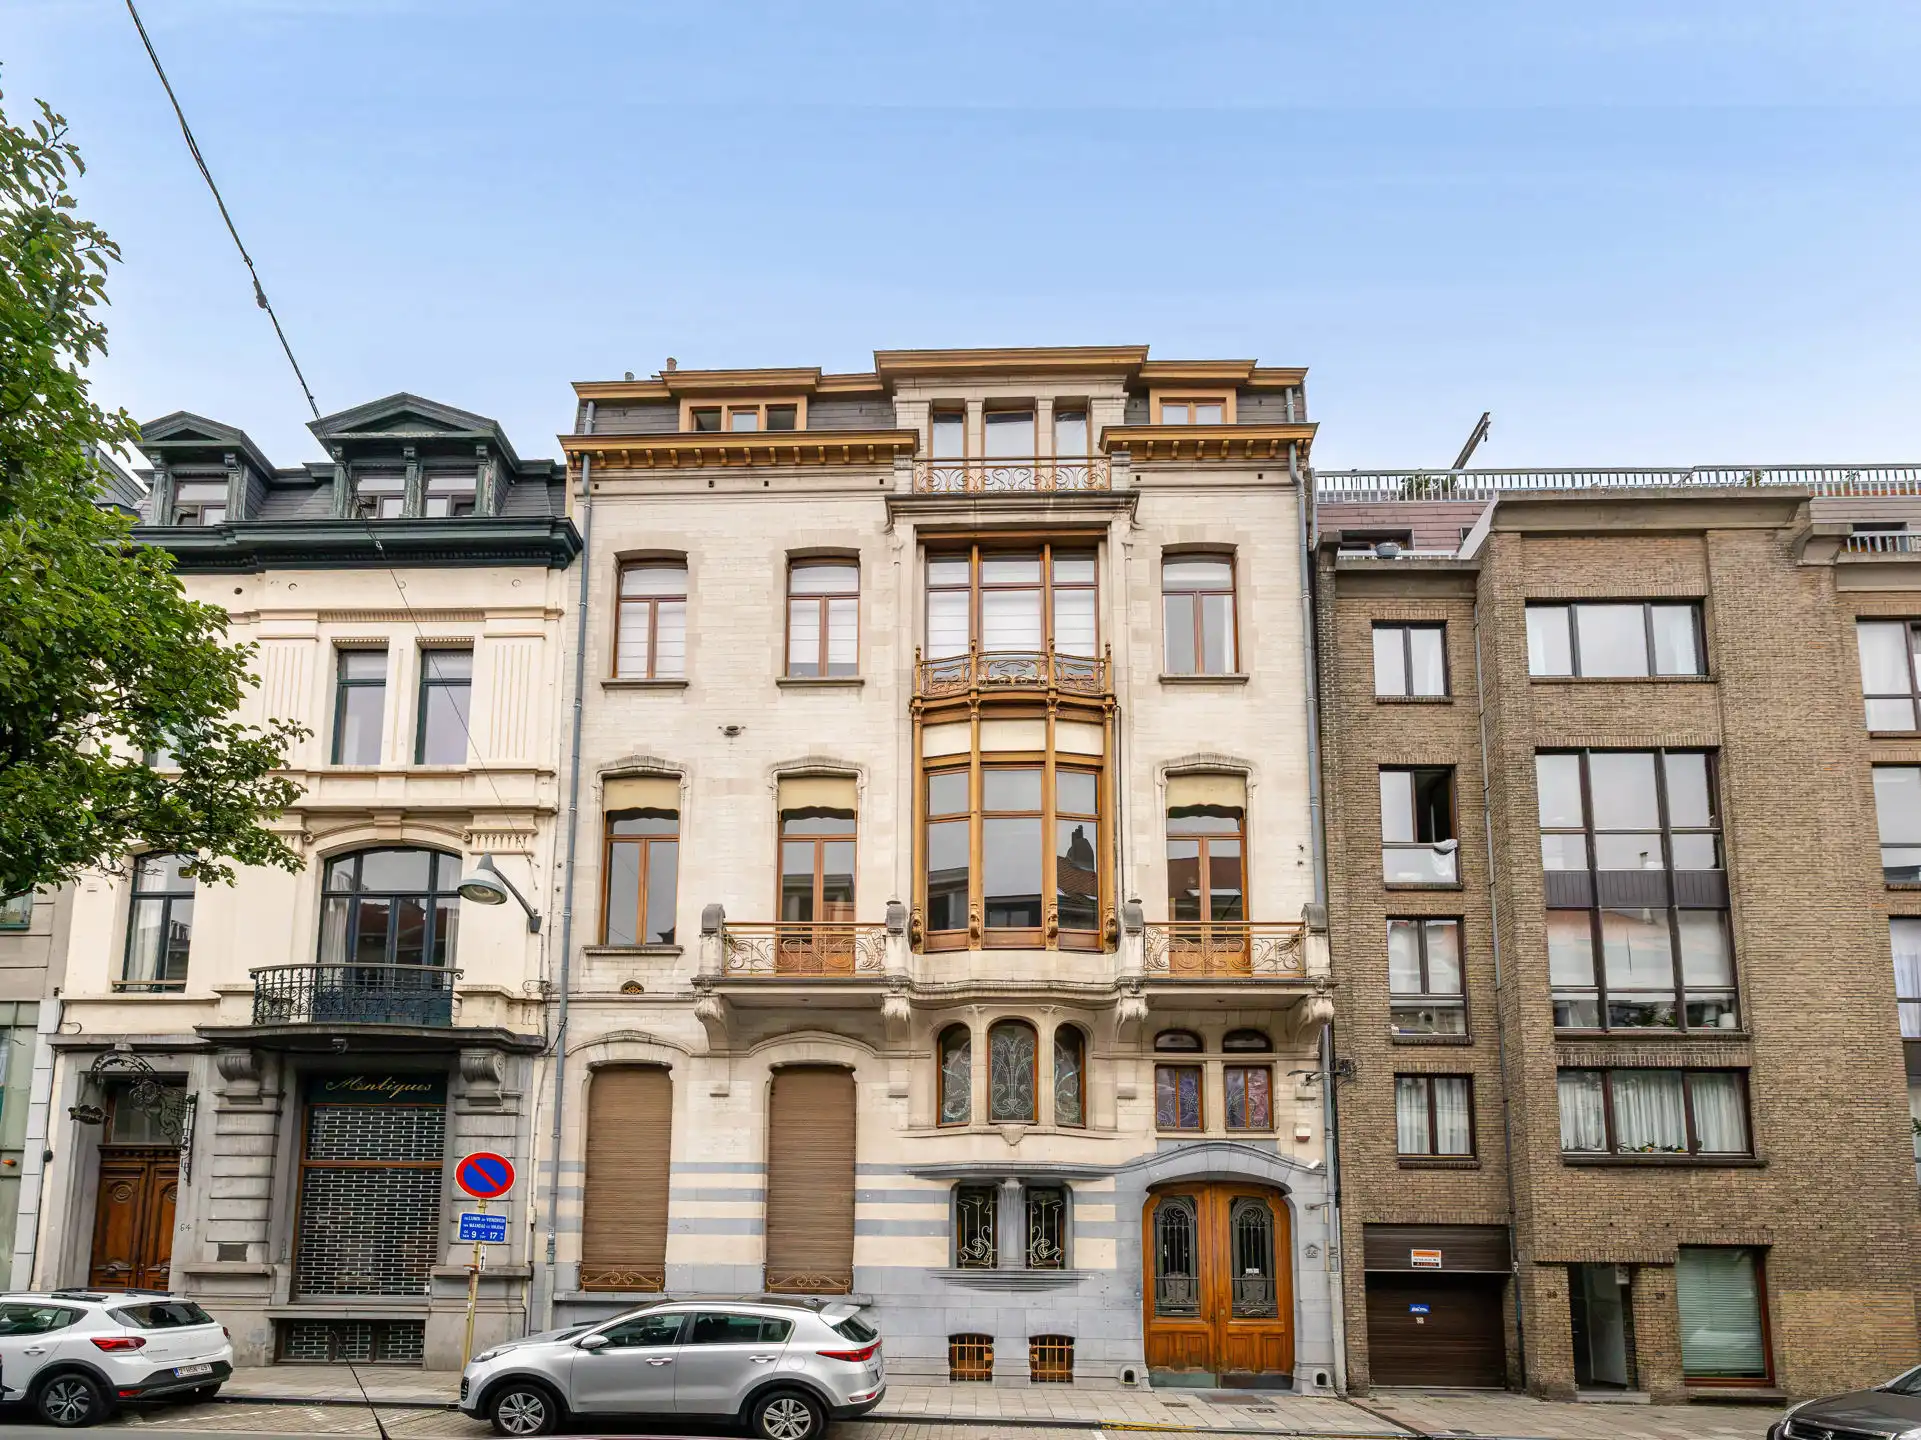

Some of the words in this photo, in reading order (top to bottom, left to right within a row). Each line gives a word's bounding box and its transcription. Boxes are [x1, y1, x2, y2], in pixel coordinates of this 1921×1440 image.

[179, 1223, 192, 1232] 64
[471, 1230, 477, 1239] 9
[489, 1231, 498, 1240] 17
